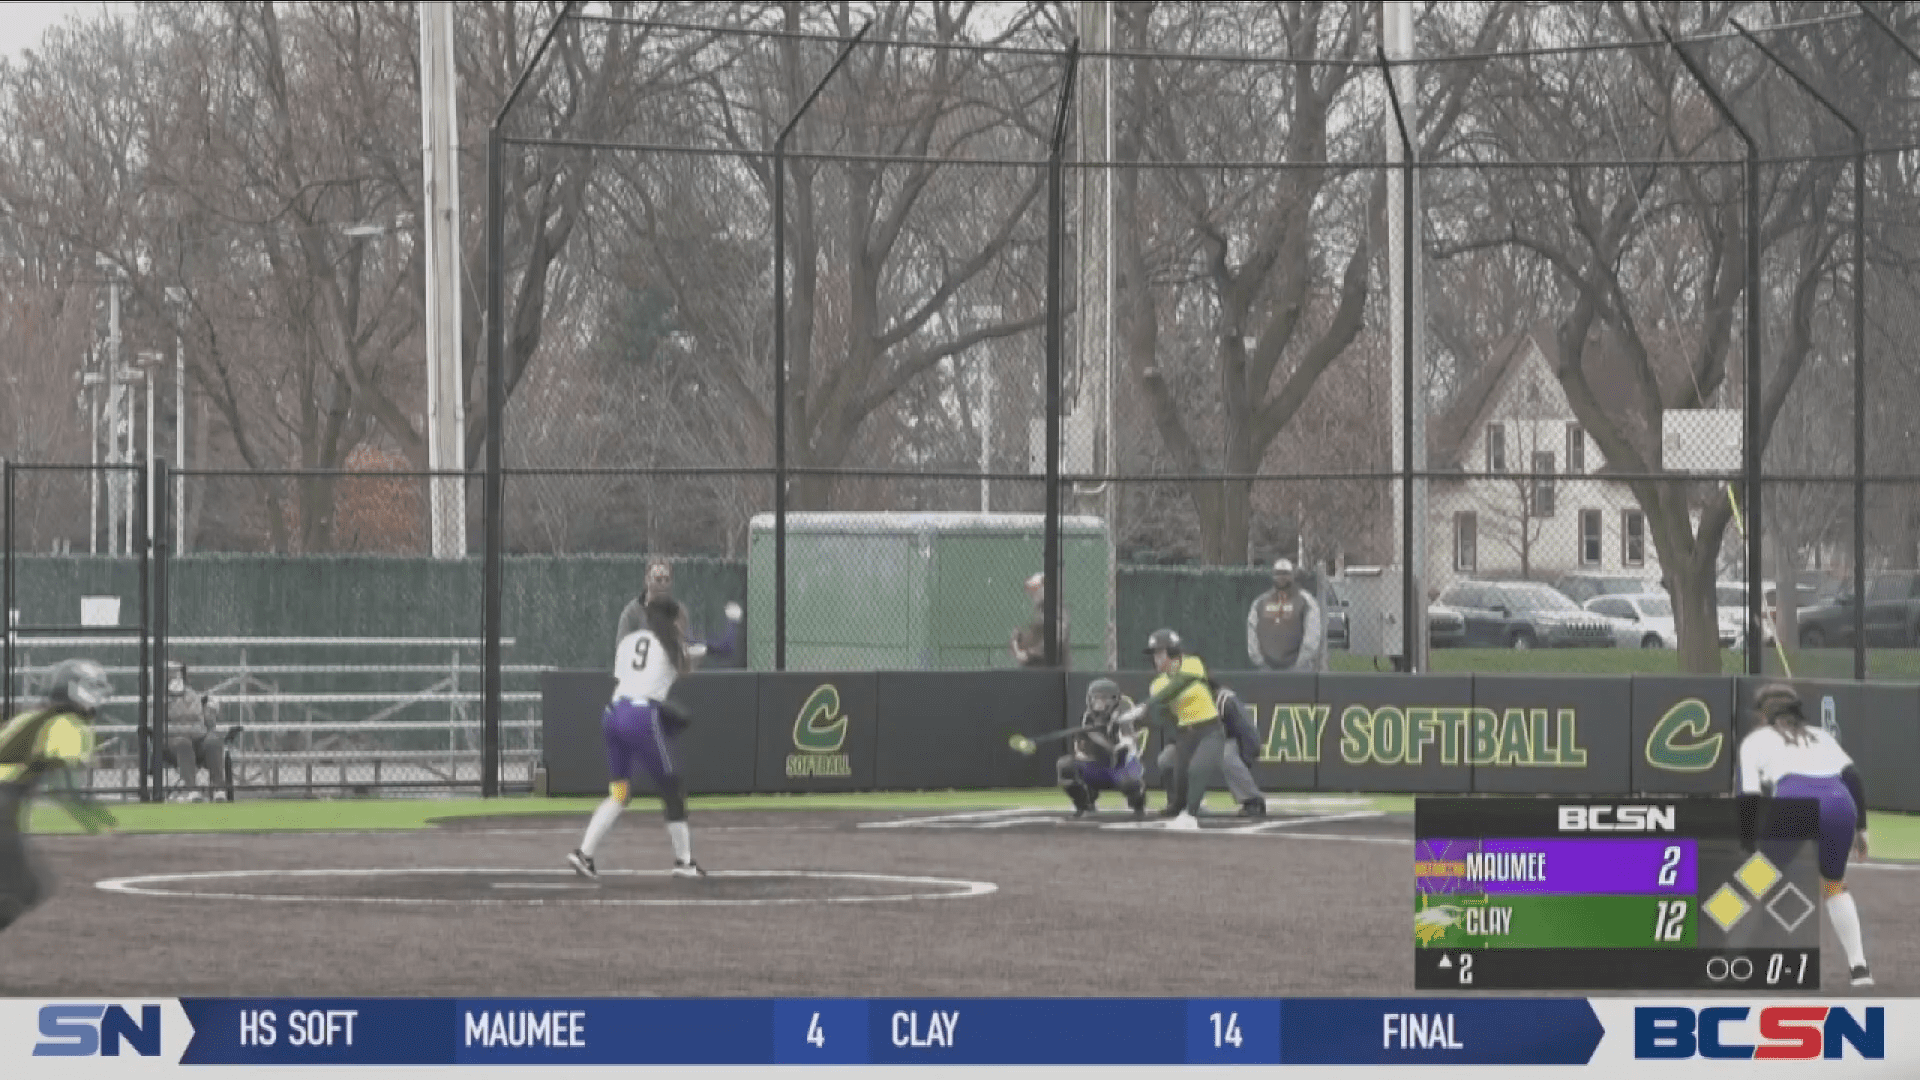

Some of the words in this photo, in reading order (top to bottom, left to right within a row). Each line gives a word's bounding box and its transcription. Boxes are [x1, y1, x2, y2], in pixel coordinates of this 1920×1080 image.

[631, 636, 650, 670] 9
[793, 684, 848, 751] C
[1242, 703, 1332, 762] AY
[1341, 705, 1587, 767] SOFTBALL
[1646, 699, 1723, 770] C
